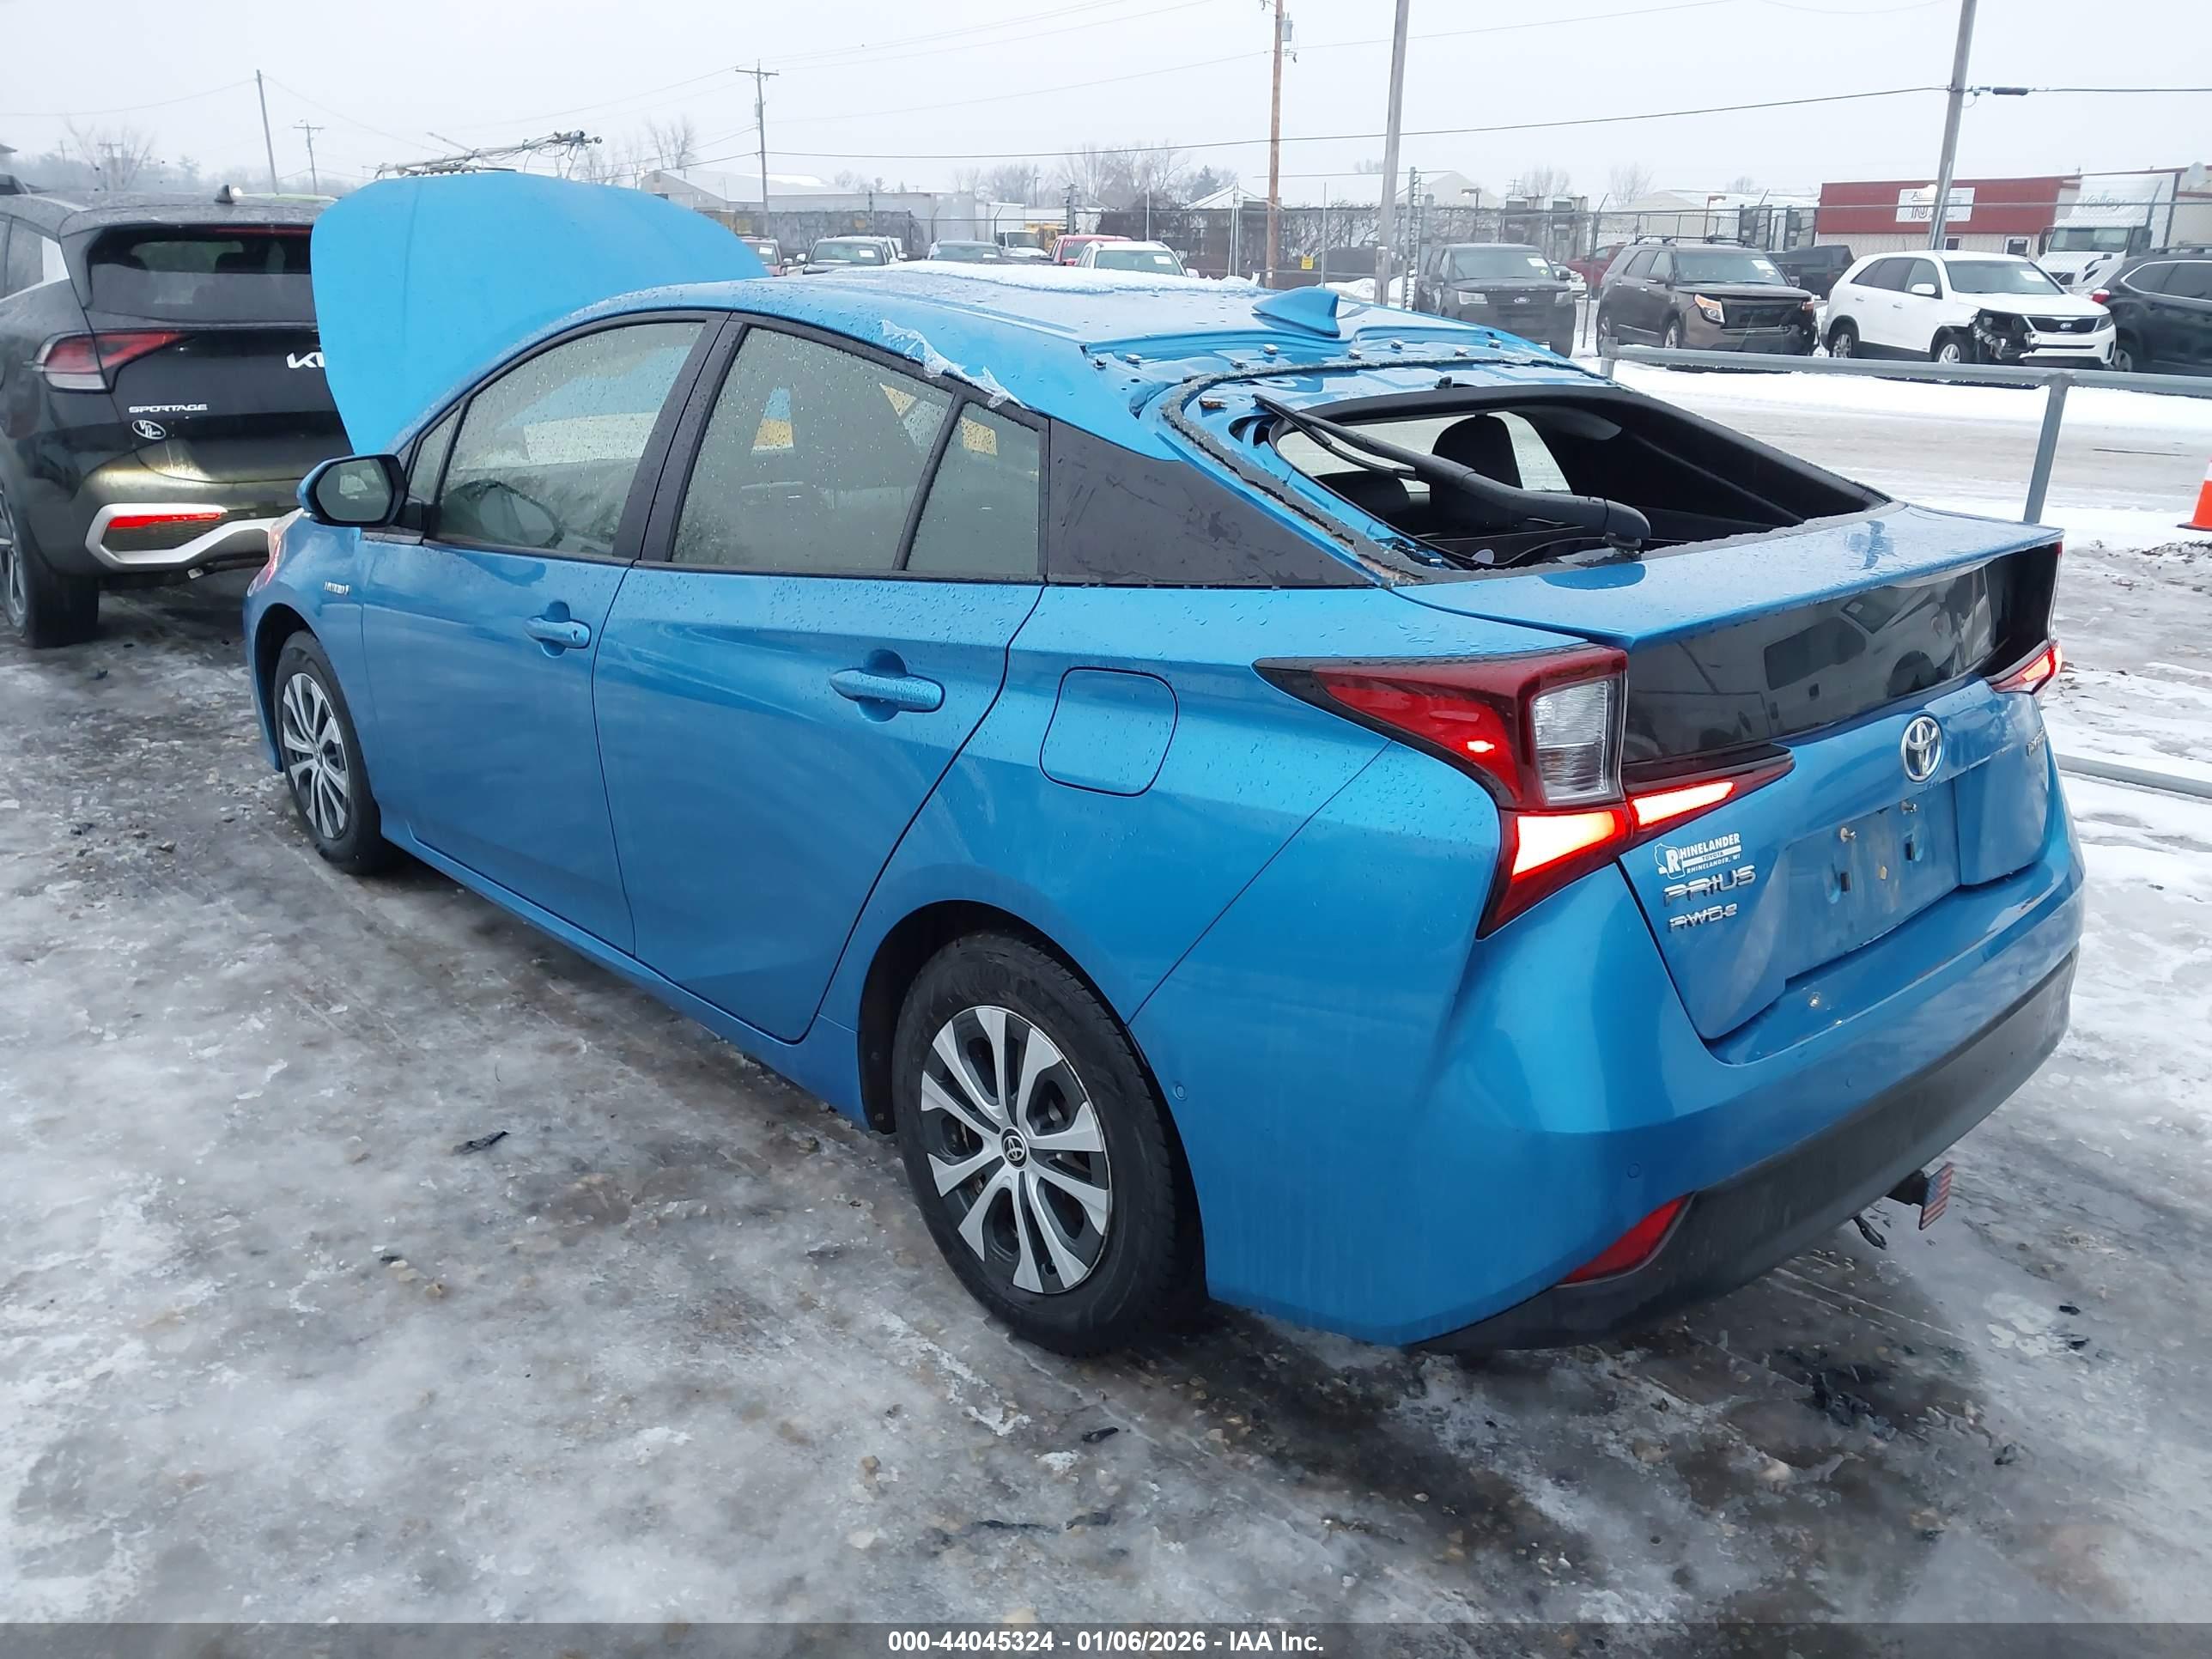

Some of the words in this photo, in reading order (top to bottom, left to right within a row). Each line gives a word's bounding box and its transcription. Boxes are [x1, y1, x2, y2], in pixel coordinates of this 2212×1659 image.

[286, 351, 325, 369] KI
[128, 404, 209, 413] SPORTAGE
[1666, 832, 1741, 874] RHINELANDER
[1702, 851, 1724, 861] TOYOTA
[1663, 865, 1757, 906] PRIUS
